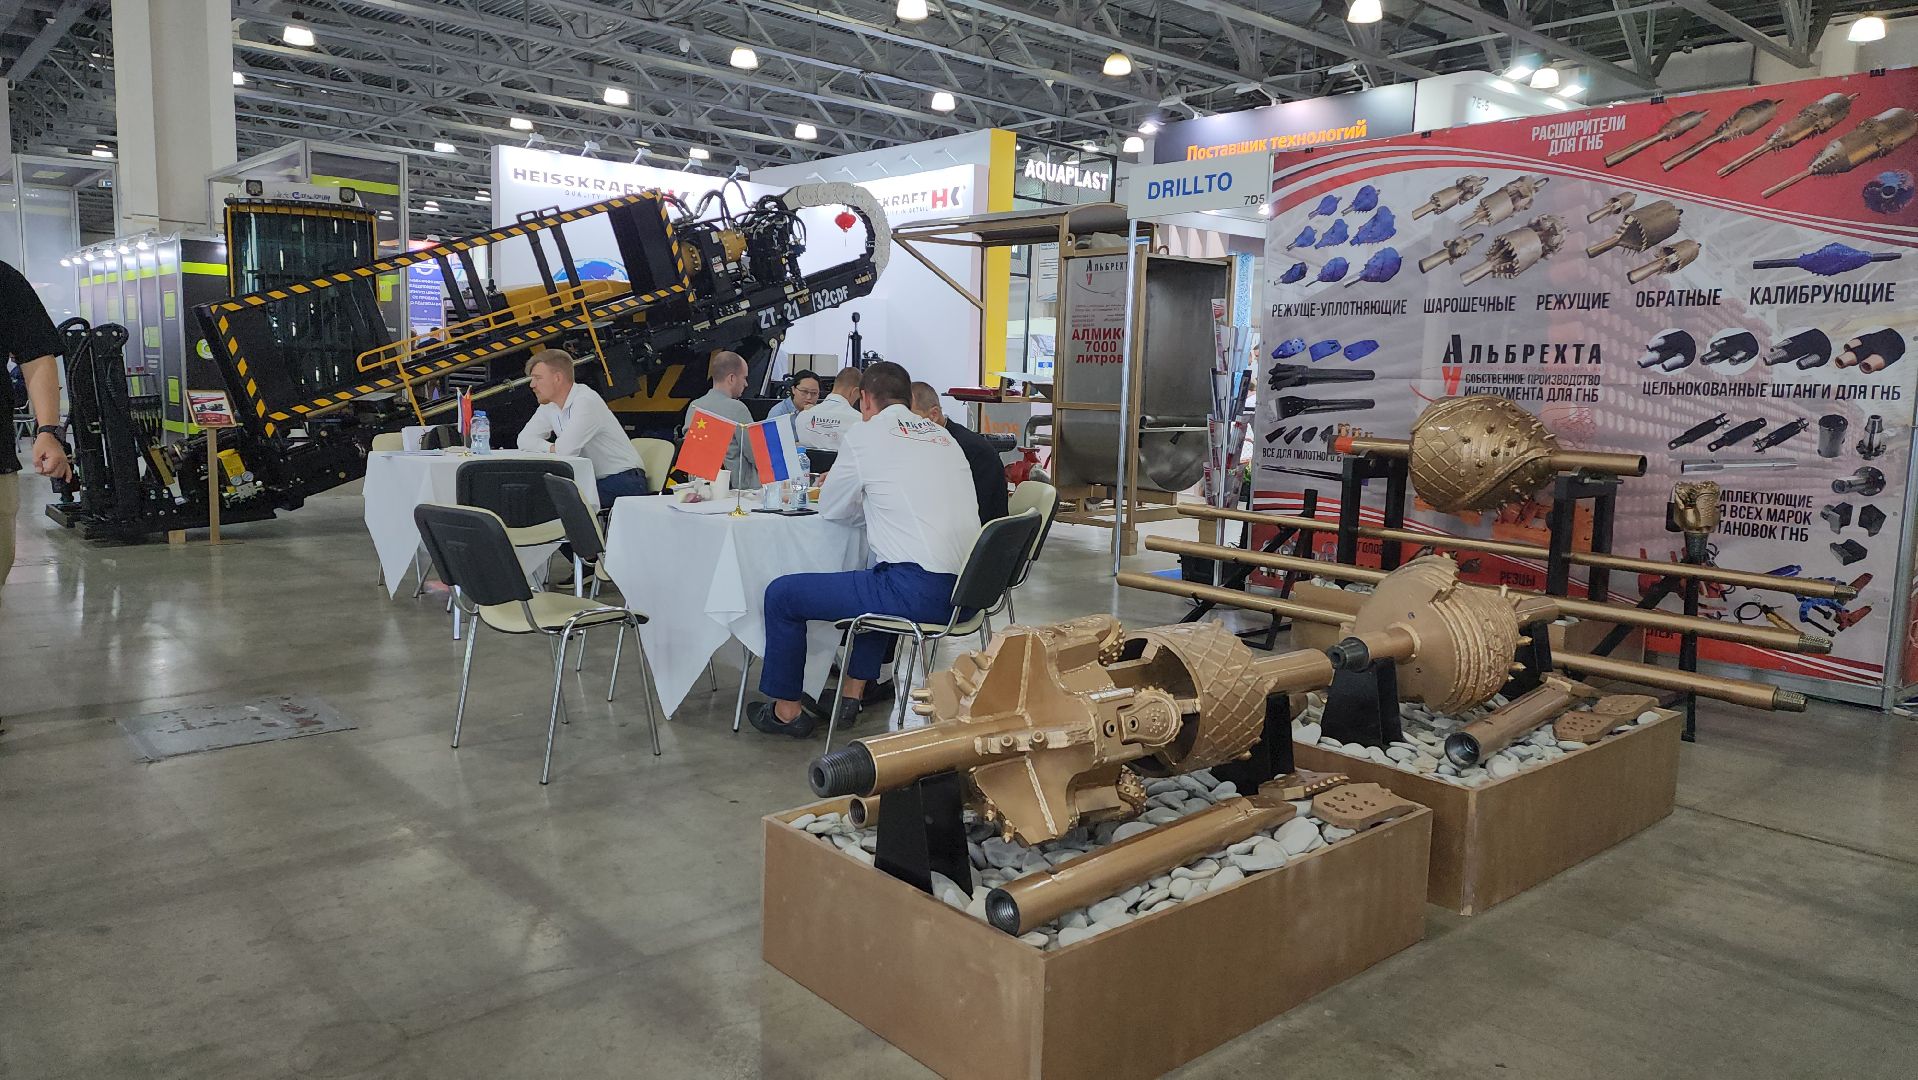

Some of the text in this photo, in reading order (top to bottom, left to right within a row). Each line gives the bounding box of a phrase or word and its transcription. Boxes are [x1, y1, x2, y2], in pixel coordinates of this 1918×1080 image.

[1532, 115, 1627, 141] РАСШИРИТЕЛИ
[1187, 119, 1367, 161] Поставщик технологий
[1548, 134, 1604, 157] ДЛЯ ГНБ
[1024, 159, 1109, 192] AQUAPLAST
[1148, 172, 1233, 200] DRILLTO
[1243, 194, 1265, 206] 7D5
[1536, 292, 1611, 311] РЕЖУЩИЕ
[1635, 288, 1722, 308] ОБРАТНЫЕ
[1749, 282, 1897, 306] КАЛИБРУЮЩИЕ
[1272, 299, 1407, 318] РЕЖУЩЕ-УПЛОТНЯЮЩИЕ
[1423, 296, 1517, 314] ШАРОШЕЧНЫЕ
[1072, 327, 1125, 341] АЛМИК
[1085, 340, 1117, 353] 7000
[1076, 353, 1124, 366] литров
[1465, 373, 1600, 386] СОБСТВЕННОЕ ПРОИЗВОДСТВО
[1546, 386, 1573, 402] ДЛЯ
[1576, 387, 1599, 402] ГНБ
[1642, 381, 1901, 401] ЦЕЛЬНОКОВАННЫЕ ШТАНГИ ДЛЯ ГНБ
[1262, 447, 1275, 458] ВСЕ
[1276, 448, 1292, 459] ДЛЯ
[1730, 504, 1763, 521] ВСЕХ
[1765, 508, 1813, 525] МАРОК
[1718, 520, 1809, 542] ТАНОВОК ГНБ
